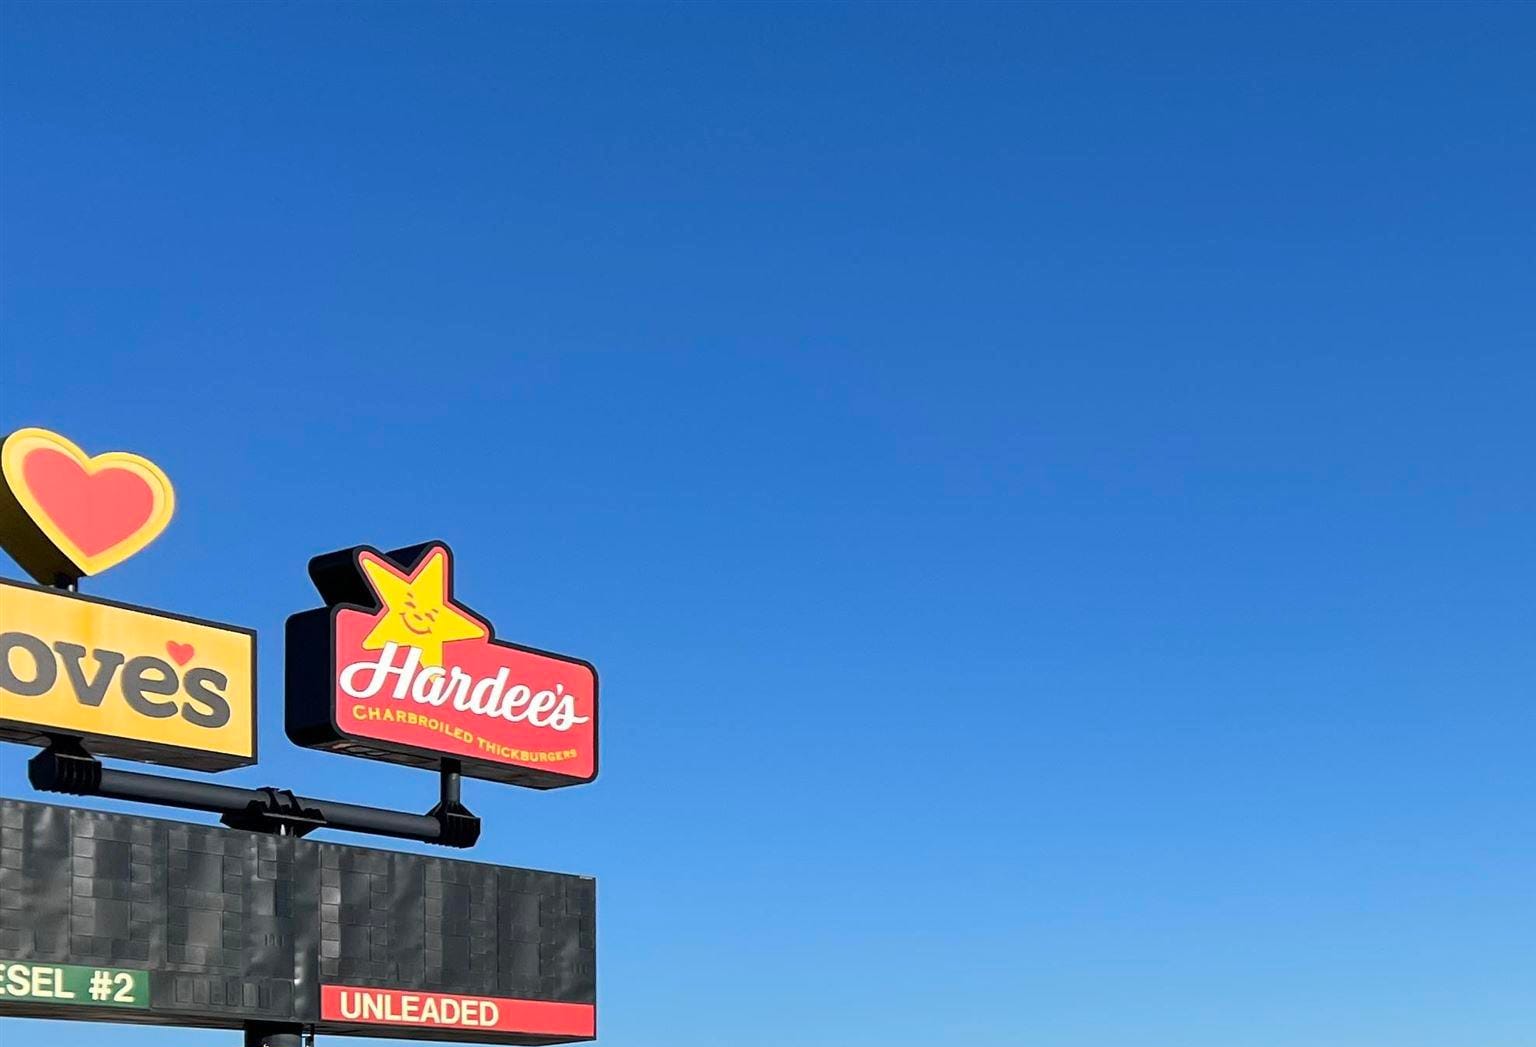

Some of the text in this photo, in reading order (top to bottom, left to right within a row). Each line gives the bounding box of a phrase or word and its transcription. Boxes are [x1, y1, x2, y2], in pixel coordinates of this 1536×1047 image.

[339, 641, 590, 731] Hardee's
[352, 704, 577, 763] CHARBROILED THICKBURGERS
[0, 963, 136, 1003] SEL #2
[340, 991, 500, 1027] UNLEADED
